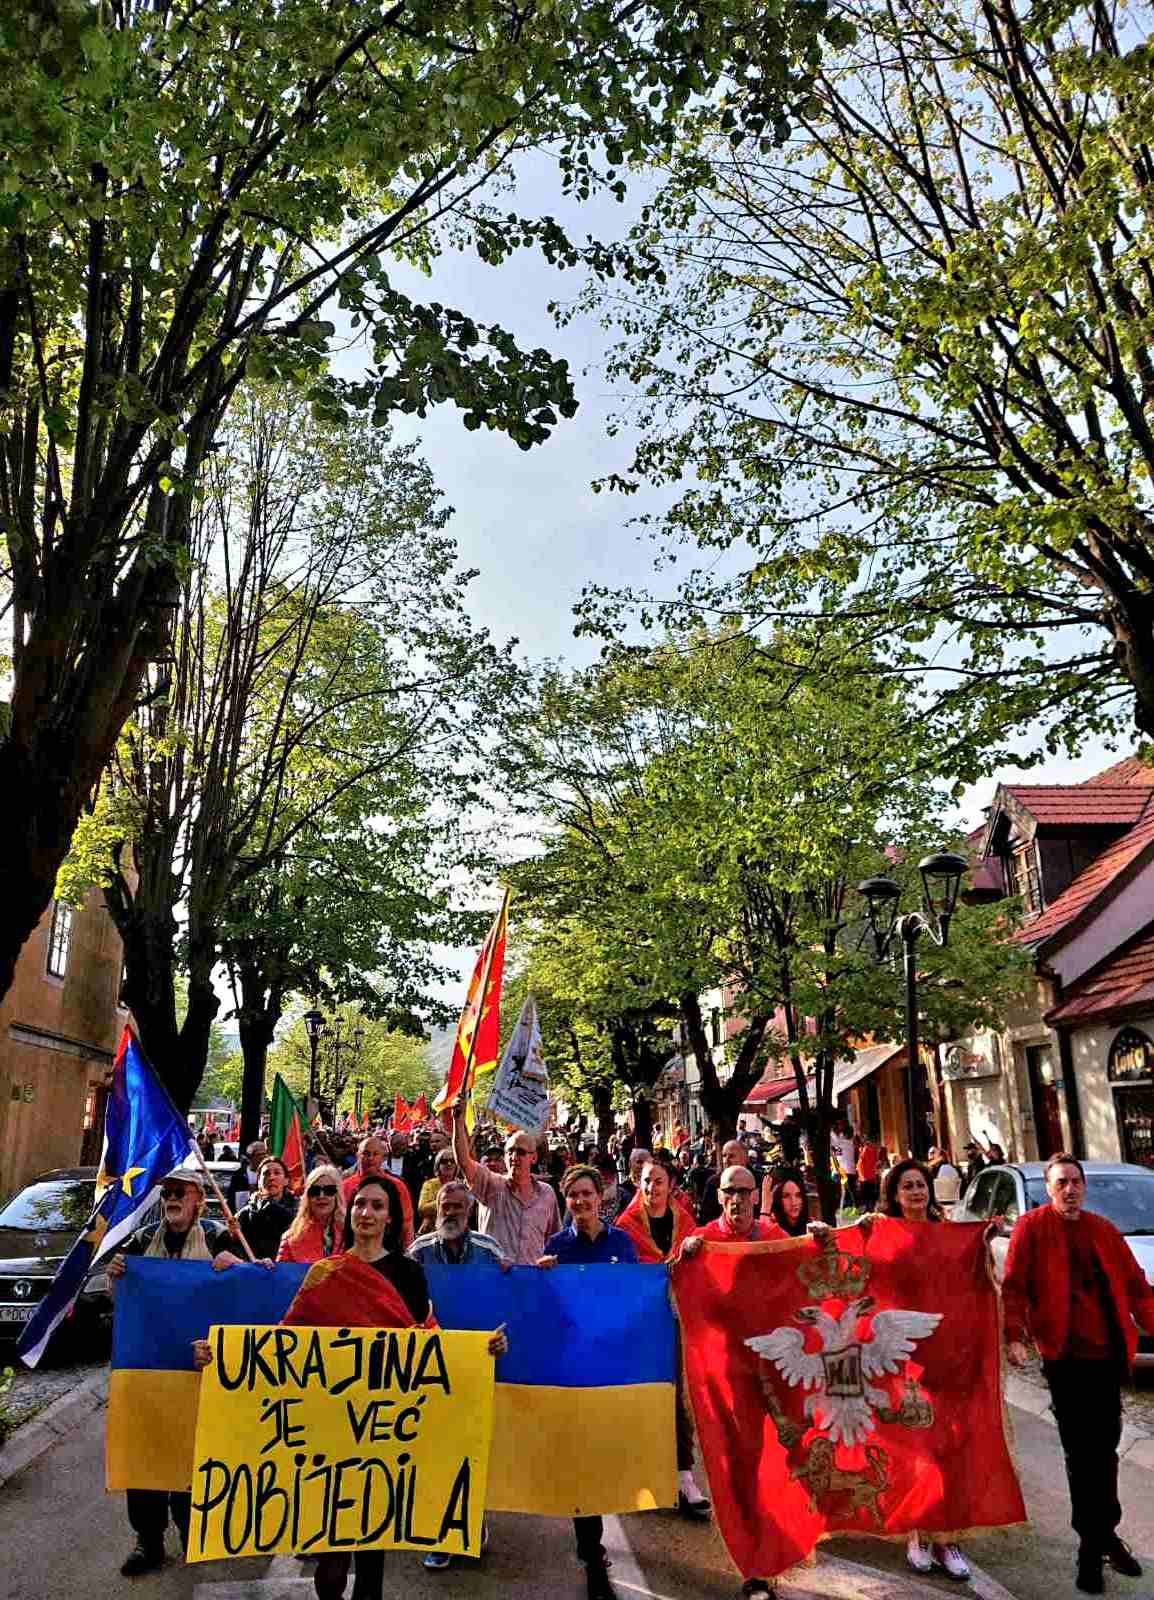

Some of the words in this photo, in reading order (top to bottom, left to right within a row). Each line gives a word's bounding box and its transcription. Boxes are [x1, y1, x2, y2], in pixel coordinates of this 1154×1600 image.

[216, 1327, 451, 1395] UKRAJINA
[260, 1397, 306, 1454] JE
[347, 1395, 428, 1444] VEĆ
[192, 1453, 471, 1555] POBIJEDILA
